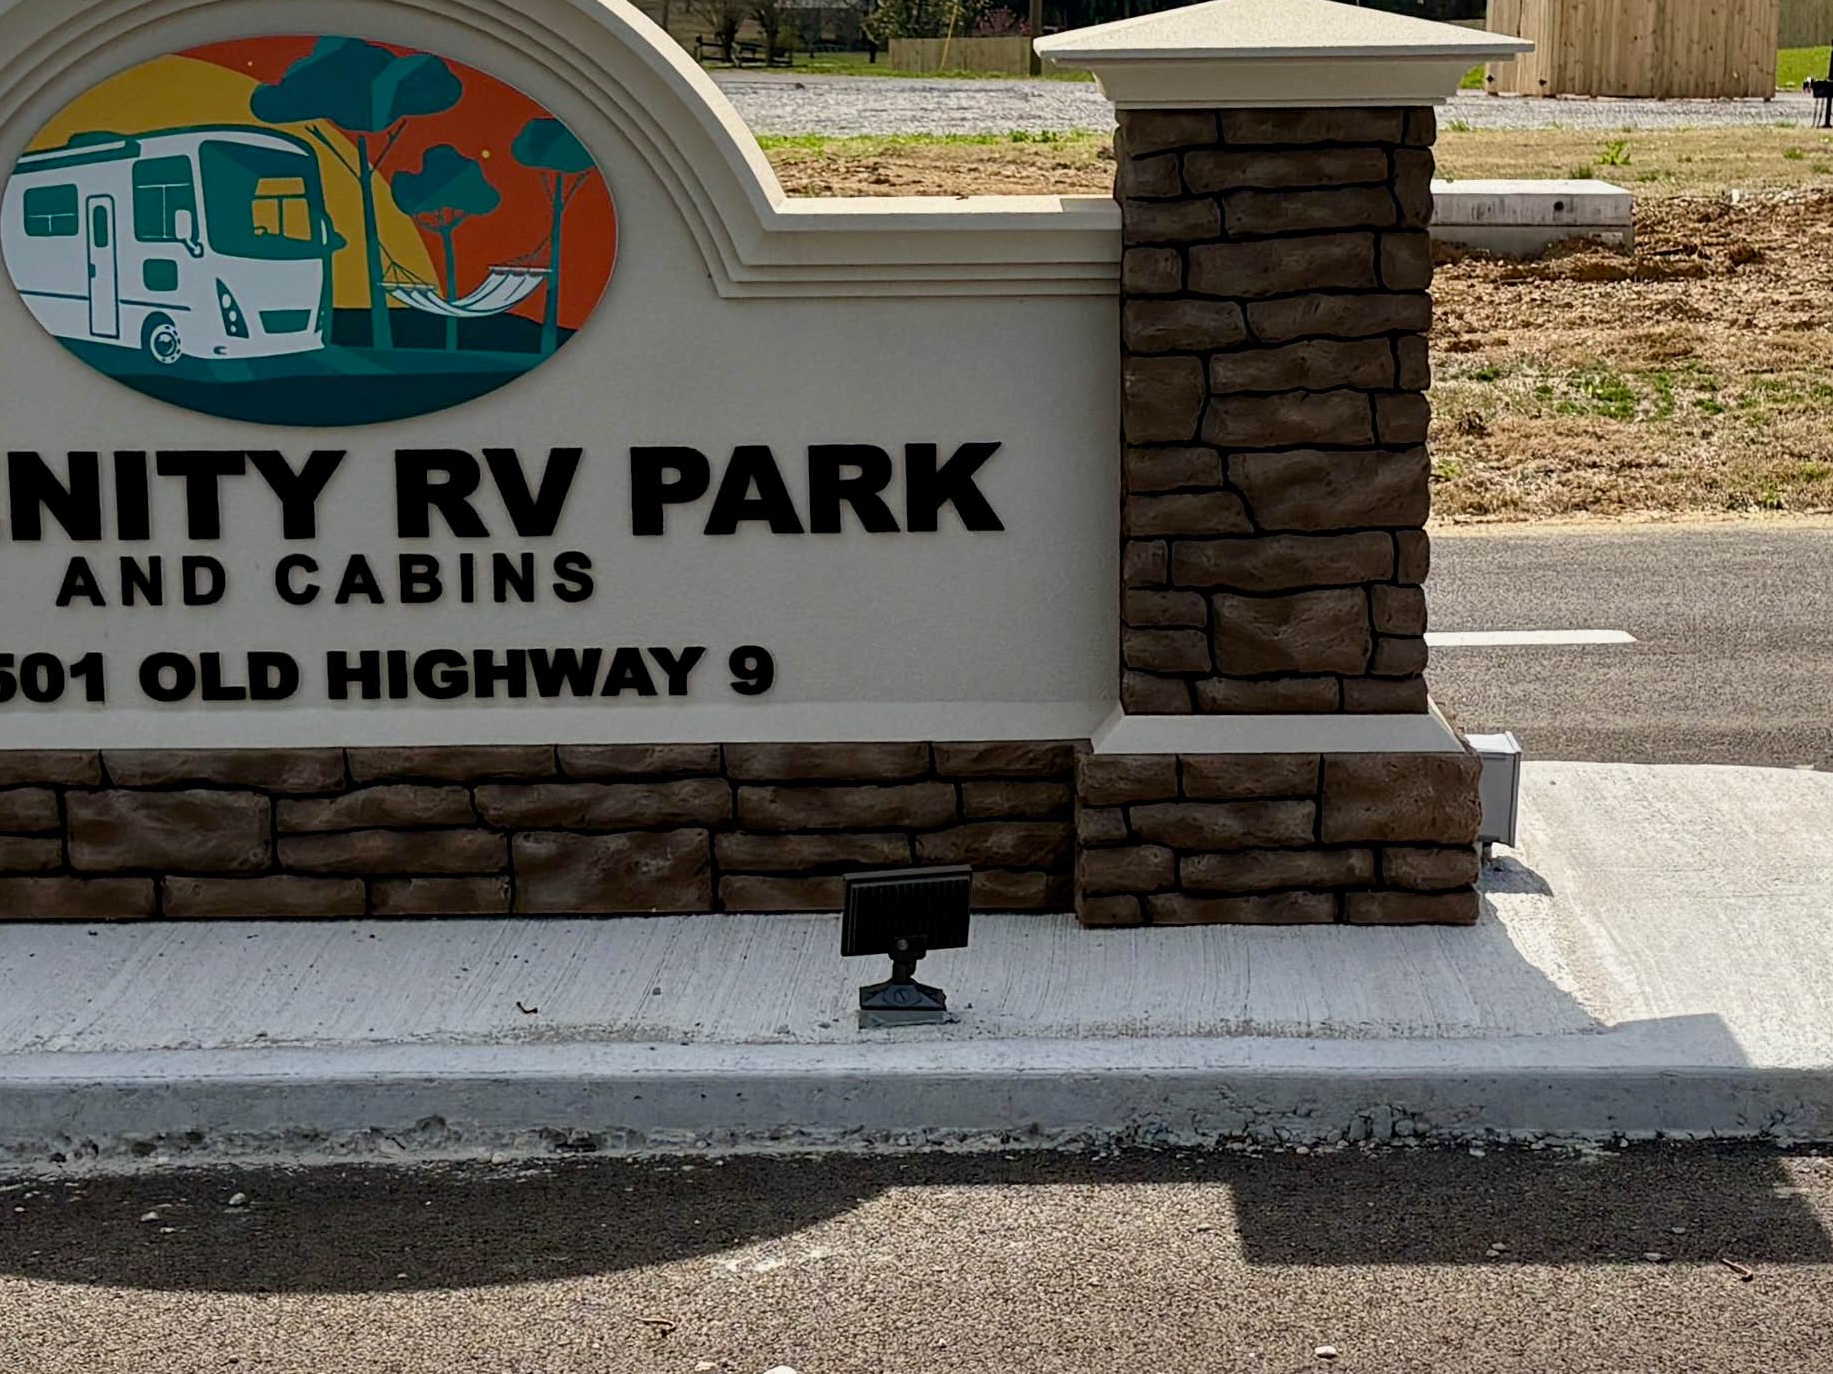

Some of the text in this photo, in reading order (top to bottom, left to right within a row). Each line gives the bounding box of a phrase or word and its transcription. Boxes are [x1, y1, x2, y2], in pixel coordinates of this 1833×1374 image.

[394, 447, 584, 539] RV
[629, 440, 1006, 537] PARK
[55, 550, 595, 608] AND CABINS
[138, 650, 300, 703] OLD
[326, 646, 707, 702] HIGHWAY
[728, 644, 775, 697] 9
